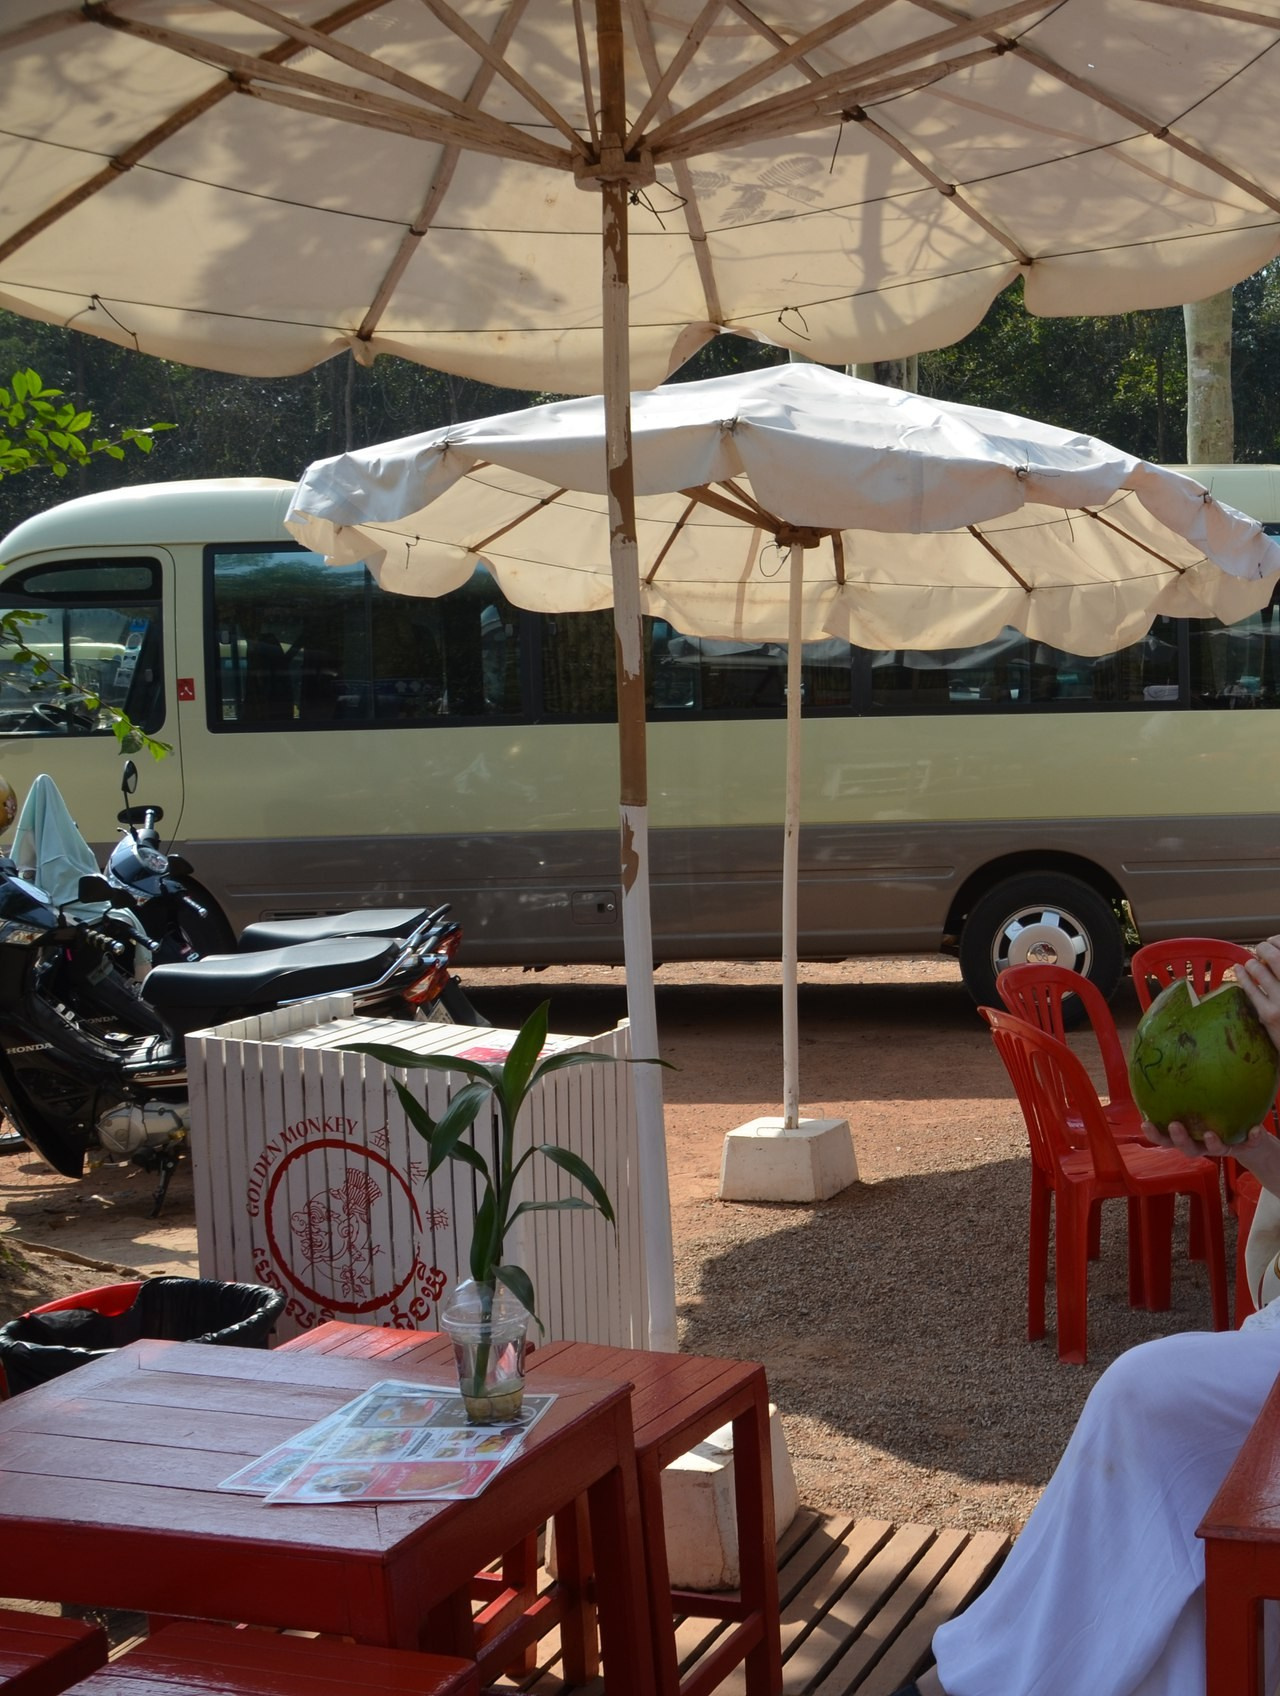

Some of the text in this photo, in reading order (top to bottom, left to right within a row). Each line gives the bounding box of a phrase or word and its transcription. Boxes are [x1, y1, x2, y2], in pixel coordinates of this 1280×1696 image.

[78, 1015, 119, 1025] ONDA
[6, 1042, 54, 1055] HONDA
[246, 1115, 359, 1218] GOLDEN MONKEY
